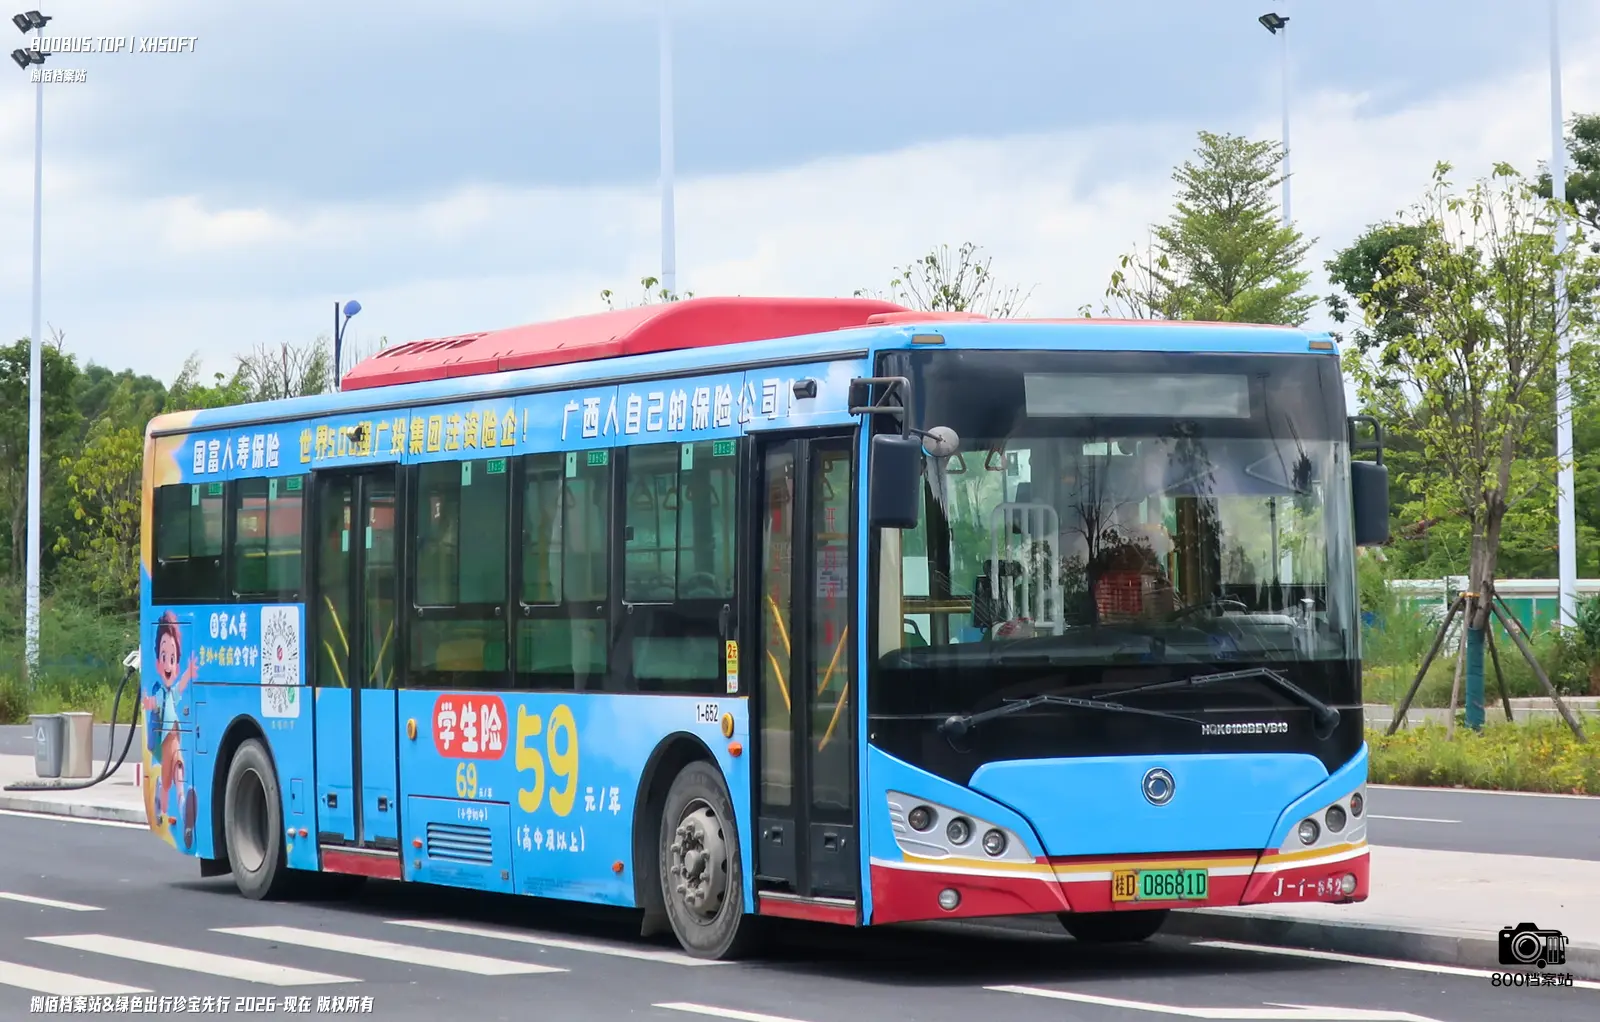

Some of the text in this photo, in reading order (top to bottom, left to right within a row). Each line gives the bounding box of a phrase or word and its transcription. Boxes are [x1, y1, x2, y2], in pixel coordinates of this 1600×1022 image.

[193, 432, 280, 474] 国富人寿保险
[209, 610, 248, 640] 国富人寿
[437, 701, 502, 752] 学生险
[697, 704, 719, 722] 1-652
[1143, 873, 1206, 896] 08681D
